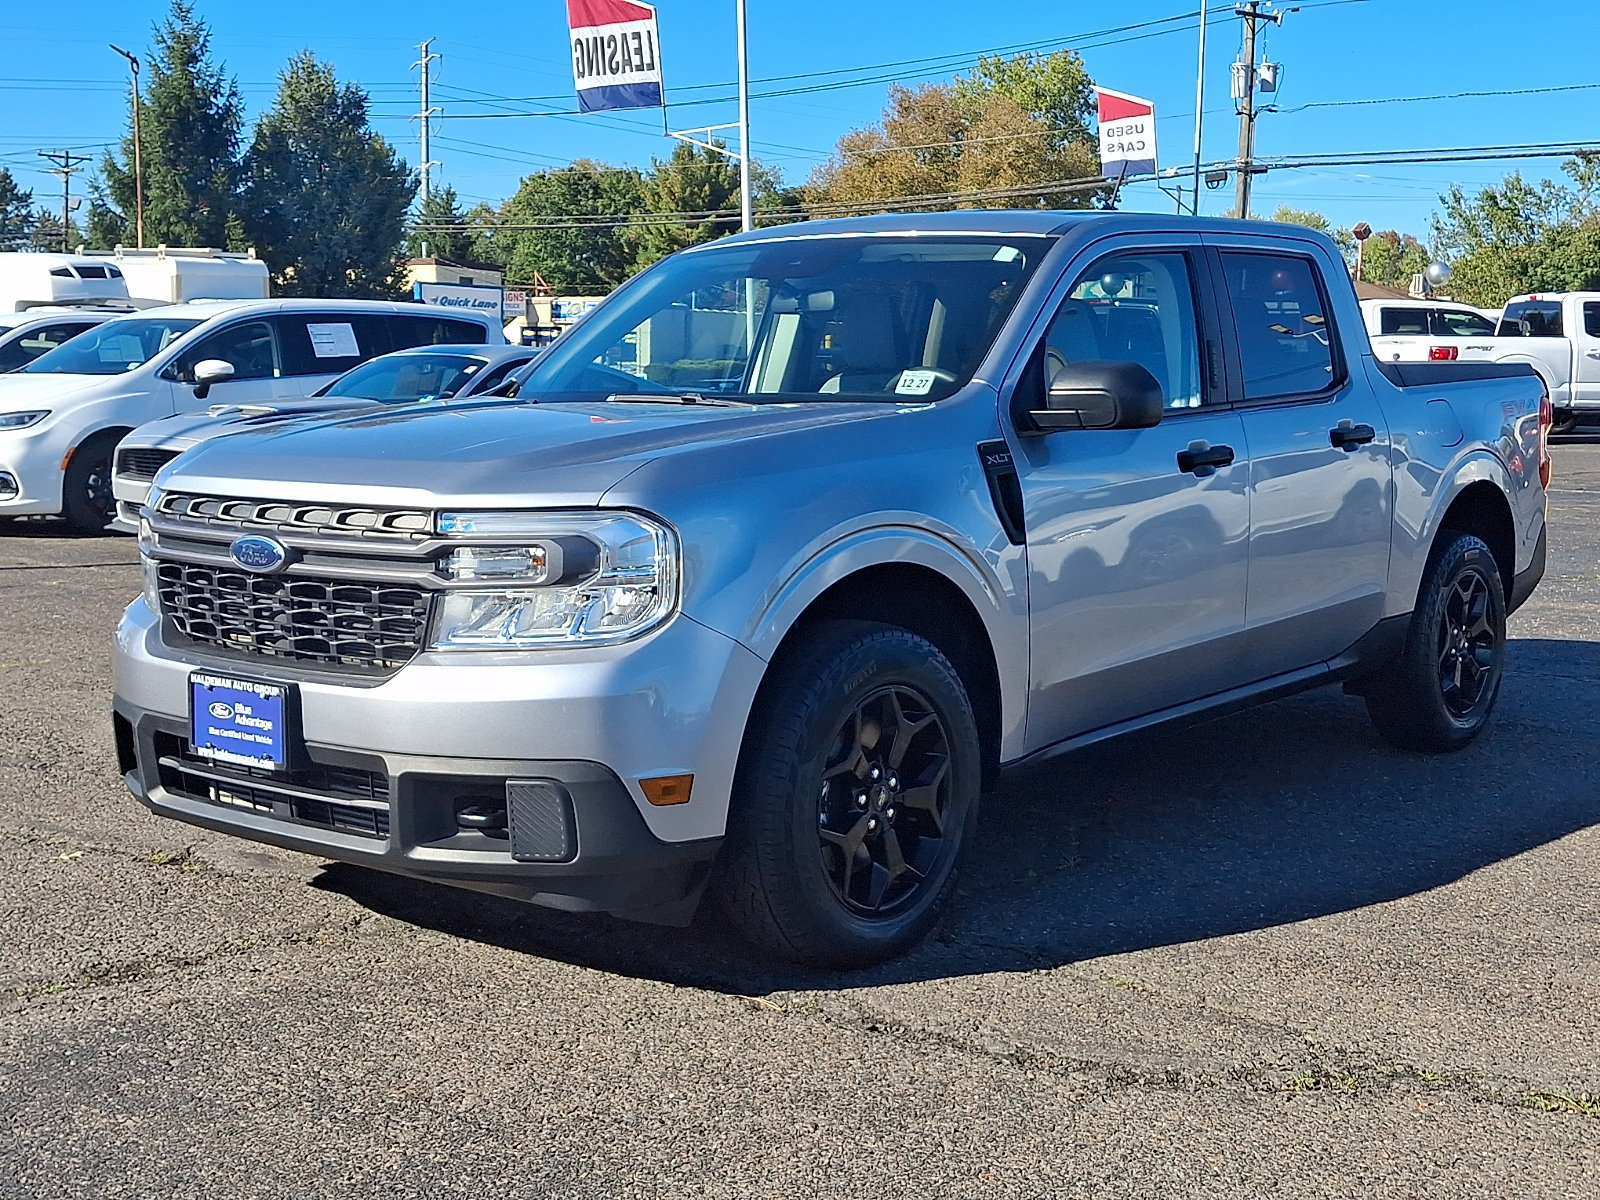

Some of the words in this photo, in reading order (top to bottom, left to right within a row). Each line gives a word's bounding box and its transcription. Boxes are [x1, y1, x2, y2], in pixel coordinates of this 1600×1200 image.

[440, 296, 469, 307] Quick
[471, 298, 498, 309] Lane
[504, 292, 524, 302] IGNS
[901, 378, 914, 388] 12
[916, 379, 929, 388] 27
[985, 453, 1010, 465] XLT
[232, 680, 253, 693] AUTO
[253, 683, 280, 697] GROUP
[234, 702, 252, 715] Blue
[234, 714, 273, 731] Advantage
[219, 728, 242, 740] Certified
[242, 731, 255, 742] Used
[254, 733, 273, 745] Vehicle
